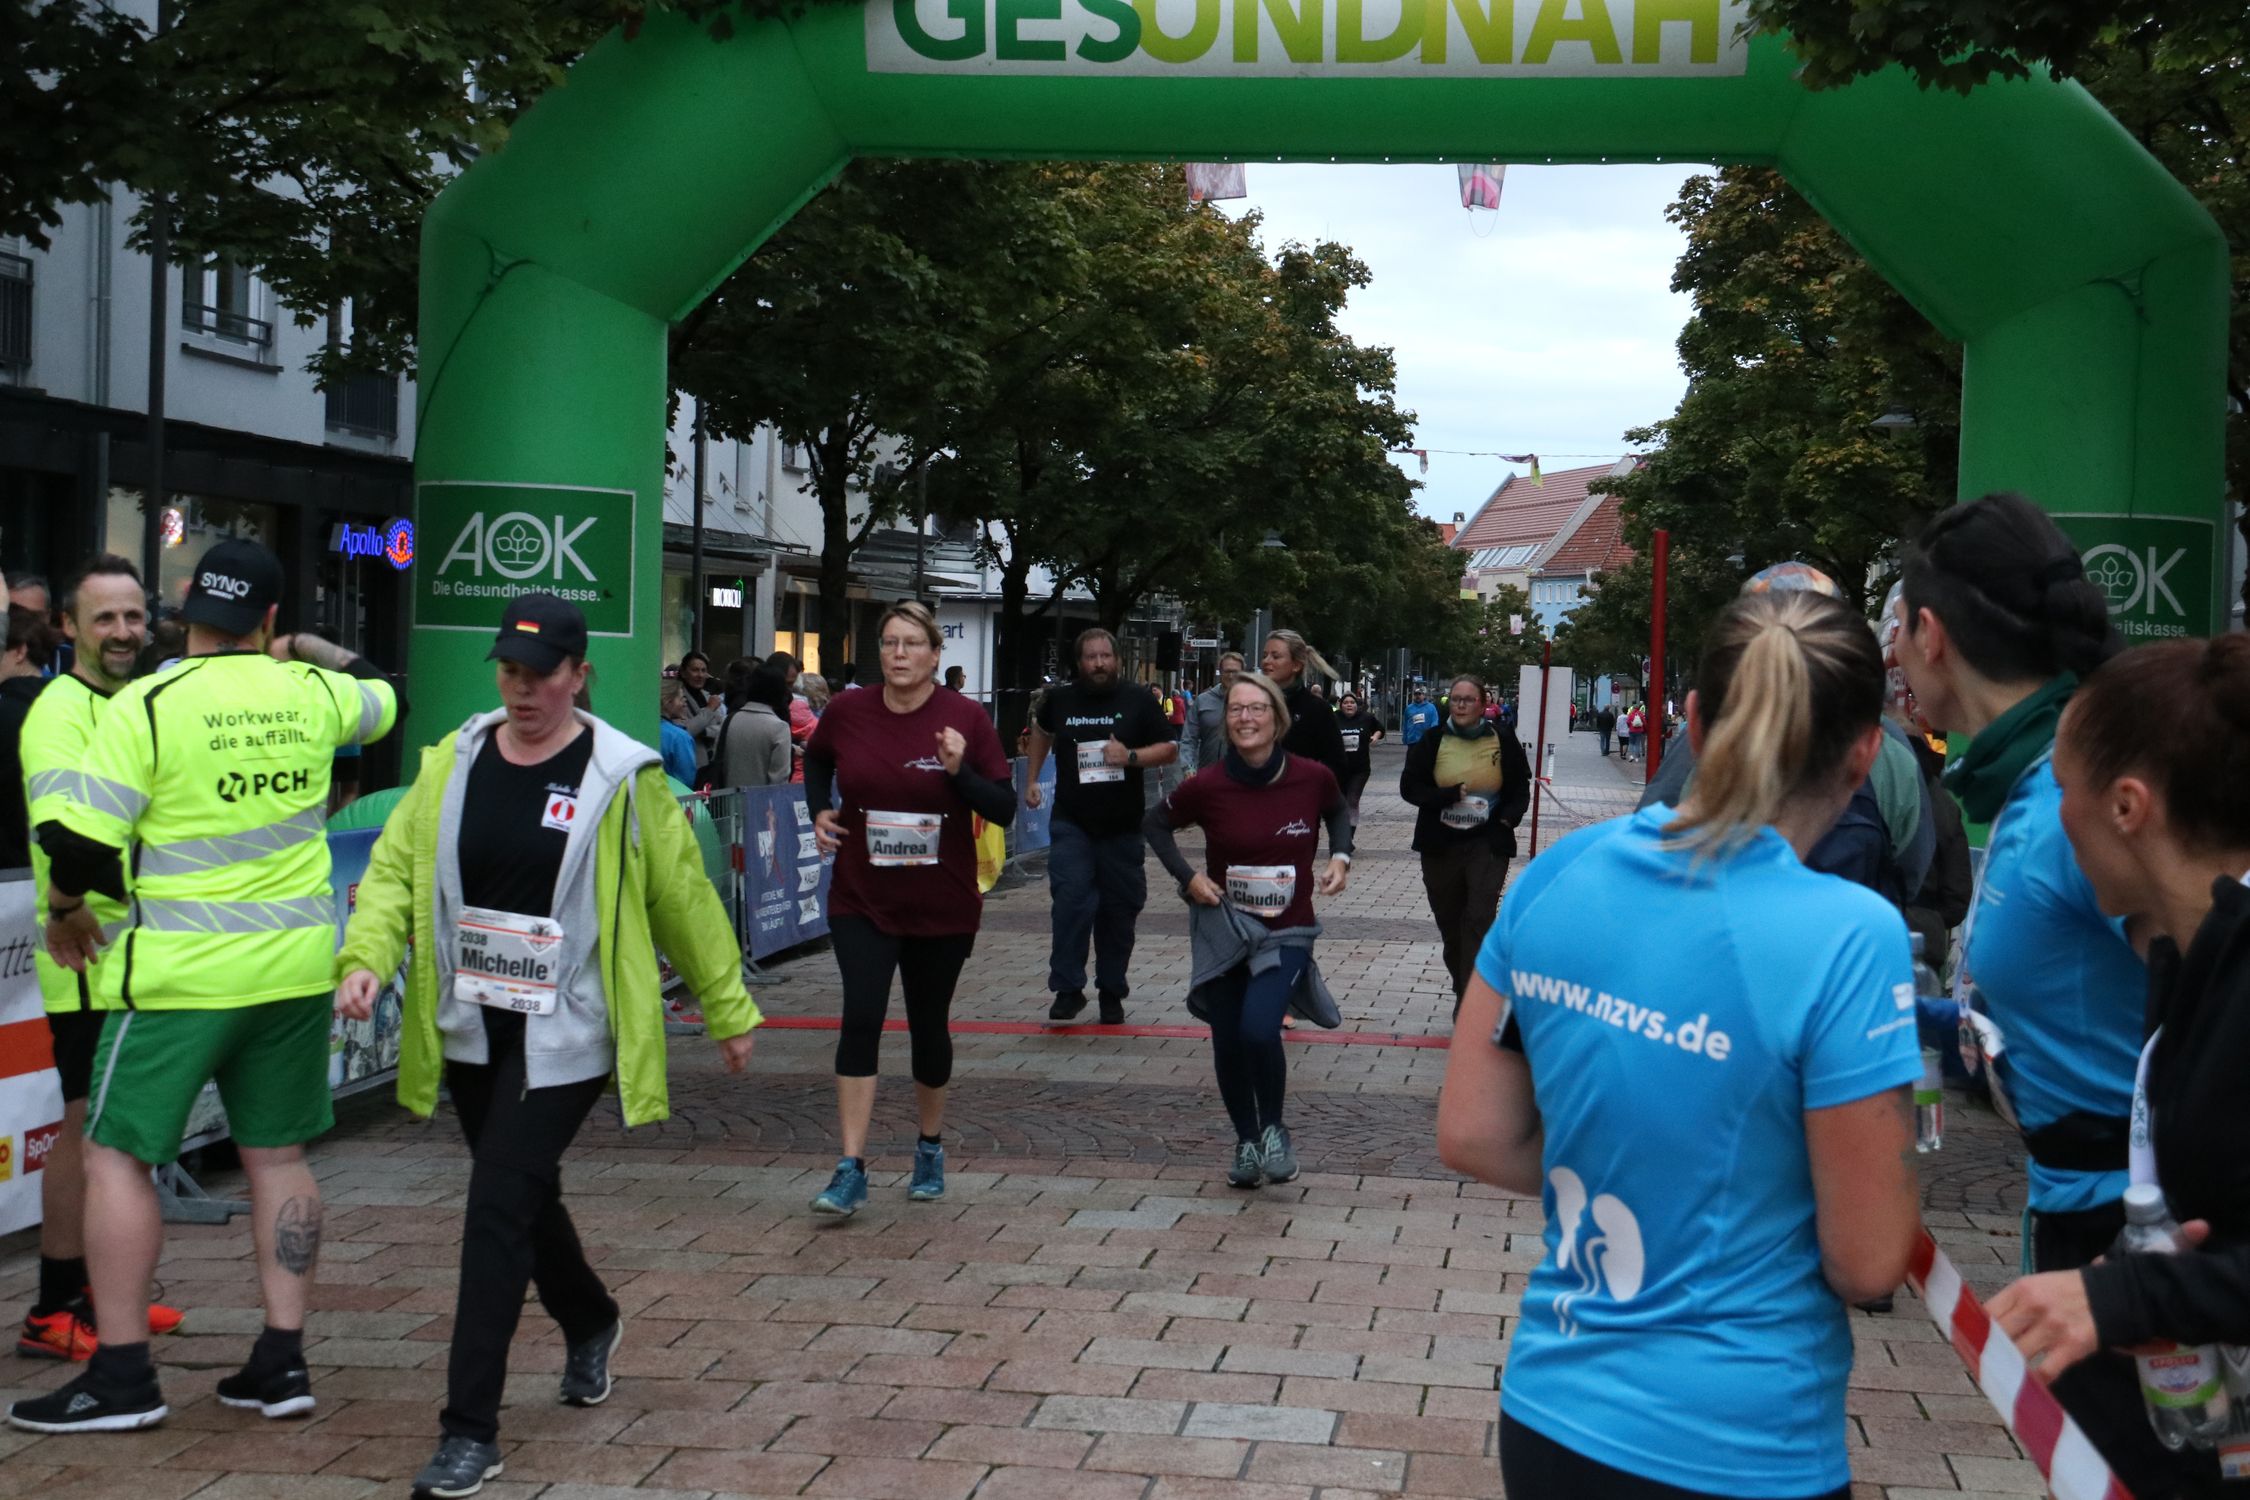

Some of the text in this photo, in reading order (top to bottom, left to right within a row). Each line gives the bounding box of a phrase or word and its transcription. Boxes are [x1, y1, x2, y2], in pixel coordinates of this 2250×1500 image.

[339, 523, 384, 561] Apollo
[436, 511, 599, 582] AOK
[432, 581, 451, 596] Die
[2080, 543, 2188, 617] OK
[203, 709, 308, 729] Workwear,
[1065, 715, 1114, 727] Alphartis
[209, 728, 311, 751] die auffällt.
[253, 768, 309, 796] PCH
[873, 840, 928, 855] Andrea
[1233, 890, 1286, 906] Claudia
[459, 930, 488, 946] 2038
[461, 946, 549, 980] Michelle
[511, 997, 541, 1011] 2038
[1511, 968, 1732, 1061] www.nzvs.de
